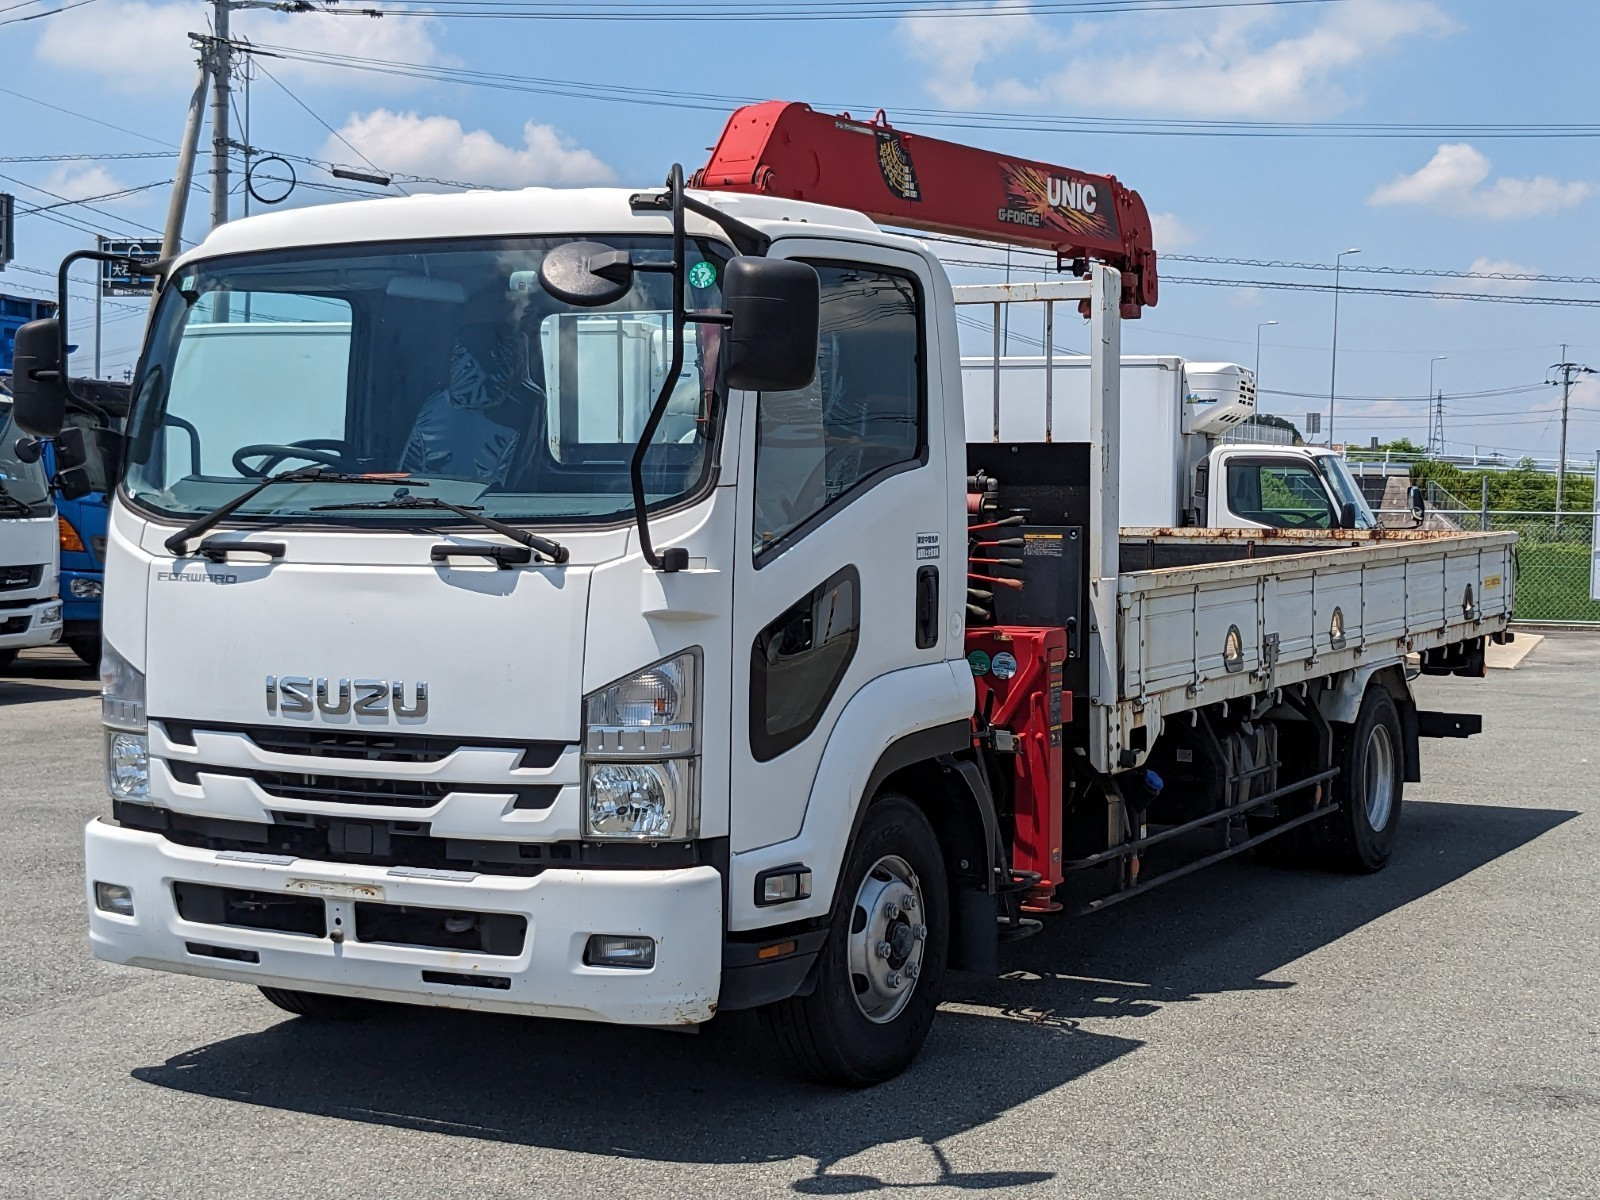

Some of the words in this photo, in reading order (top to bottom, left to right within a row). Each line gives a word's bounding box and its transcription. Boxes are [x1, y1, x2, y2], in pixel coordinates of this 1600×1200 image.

[1047, 177, 1097, 214] UNIC
[157, 571, 238, 585] FORWARD
[266, 675, 428, 718] ISUZU
